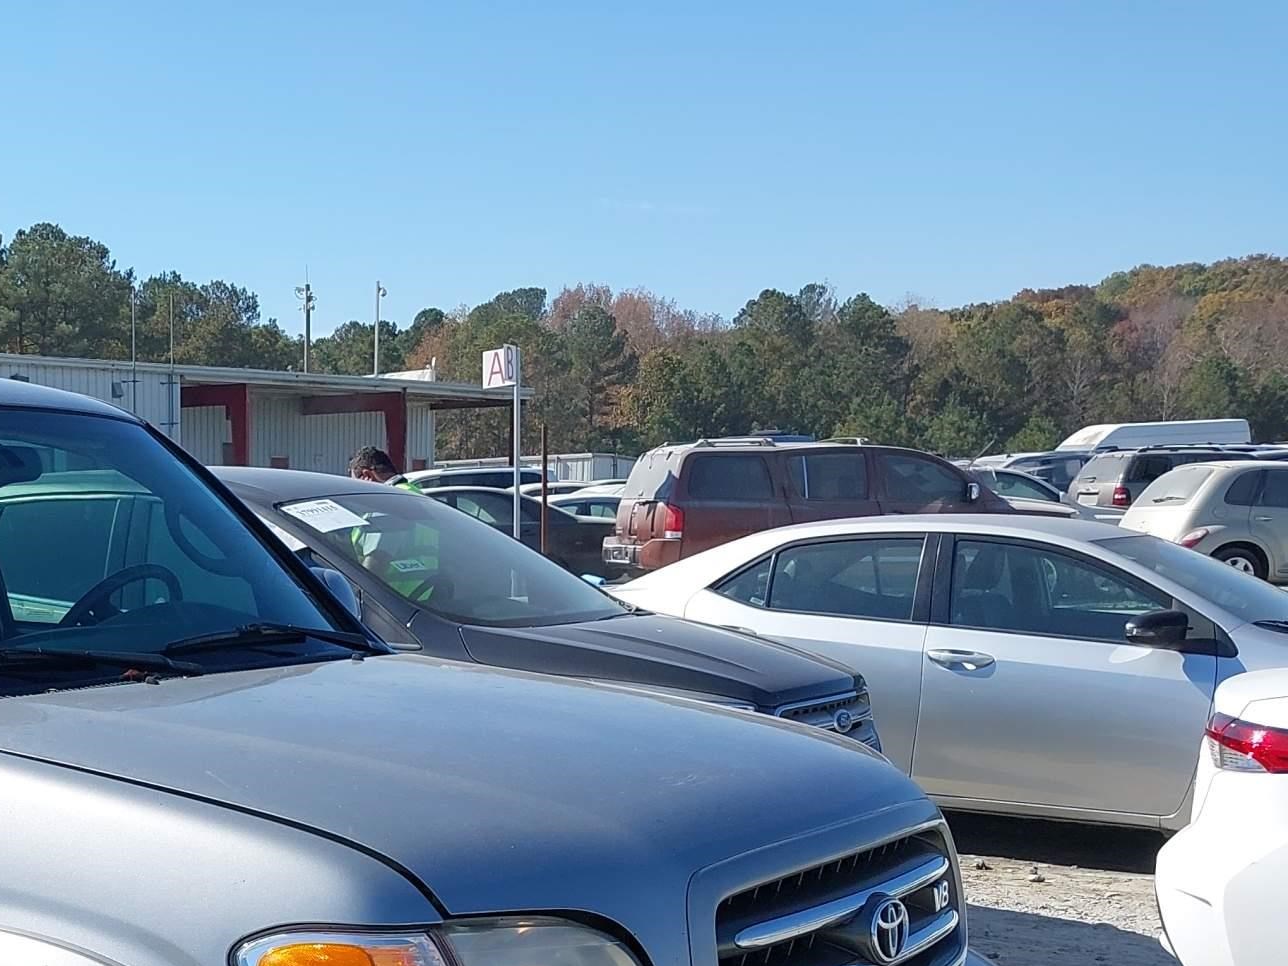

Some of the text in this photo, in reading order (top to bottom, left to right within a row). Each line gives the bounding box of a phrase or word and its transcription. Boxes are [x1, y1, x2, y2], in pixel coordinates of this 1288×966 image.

[488, 351, 505, 386] A
[507, 346, 514, 380] B
[933, 880, 950, 912] V8
